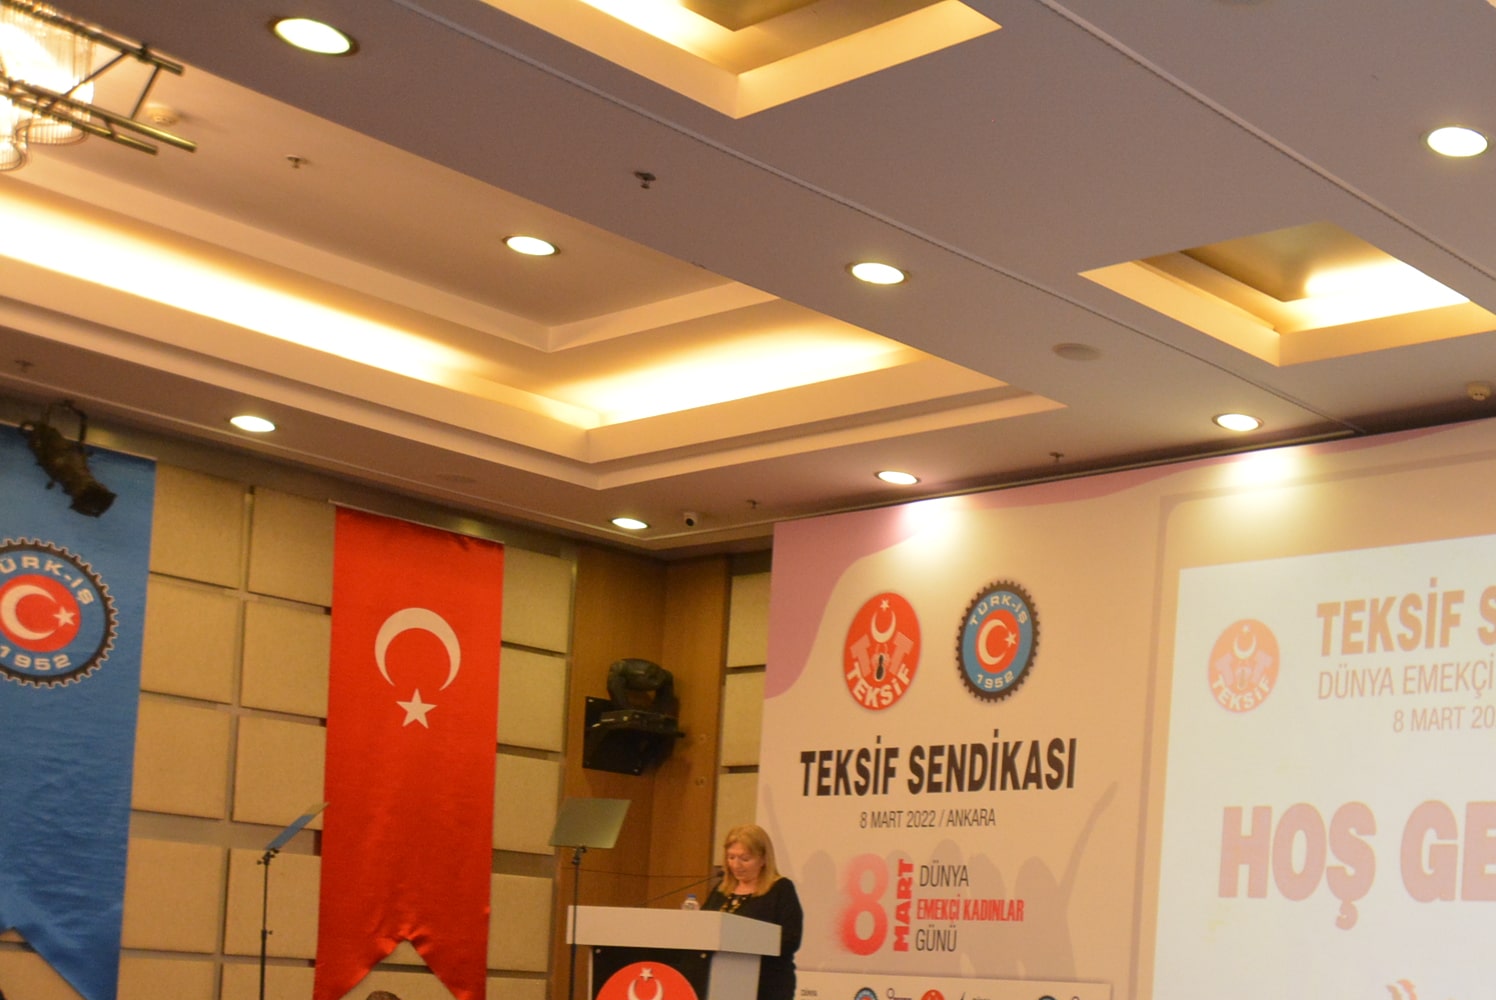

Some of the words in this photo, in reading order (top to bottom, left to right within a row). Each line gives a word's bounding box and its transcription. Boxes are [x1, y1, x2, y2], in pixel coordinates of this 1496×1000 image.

[1316, 577, 1466, 657] TEKSİF
[0, 645, 72, 671] 1952
[1317, 664, 1395, 700] DÜNYA
[1401, 652, 1495, 700] EMEKÇİ
[847, 661, 911, 708] TEKSİF
[976, 671, 1014, 689] 1952
[1392, 709, 1404, 733] 8
[1410, 706, 1466, 732] MART
[800, 735, 900, 797] TEKSİF
[907, 728, 1077, 795] SENDİKASI
[860, 811, 867, 829] 8
[871, 810, 904, 829] MART
[906, 810, 936, 828] 2022
[946, 808, 996, 827] ANKARA
[919, 859, 970, 887] DÜNYA
[1217, 801, 1377, 931] HOŞ
[838, 853, 890, 956] 8
[893, 858, 914, 952] MART
[916, 893, 961, 924] EMEKÇİ
[963, 898, 1024, 922] KADINLAR
[915, 924, 958, 953] GÜNÜ
